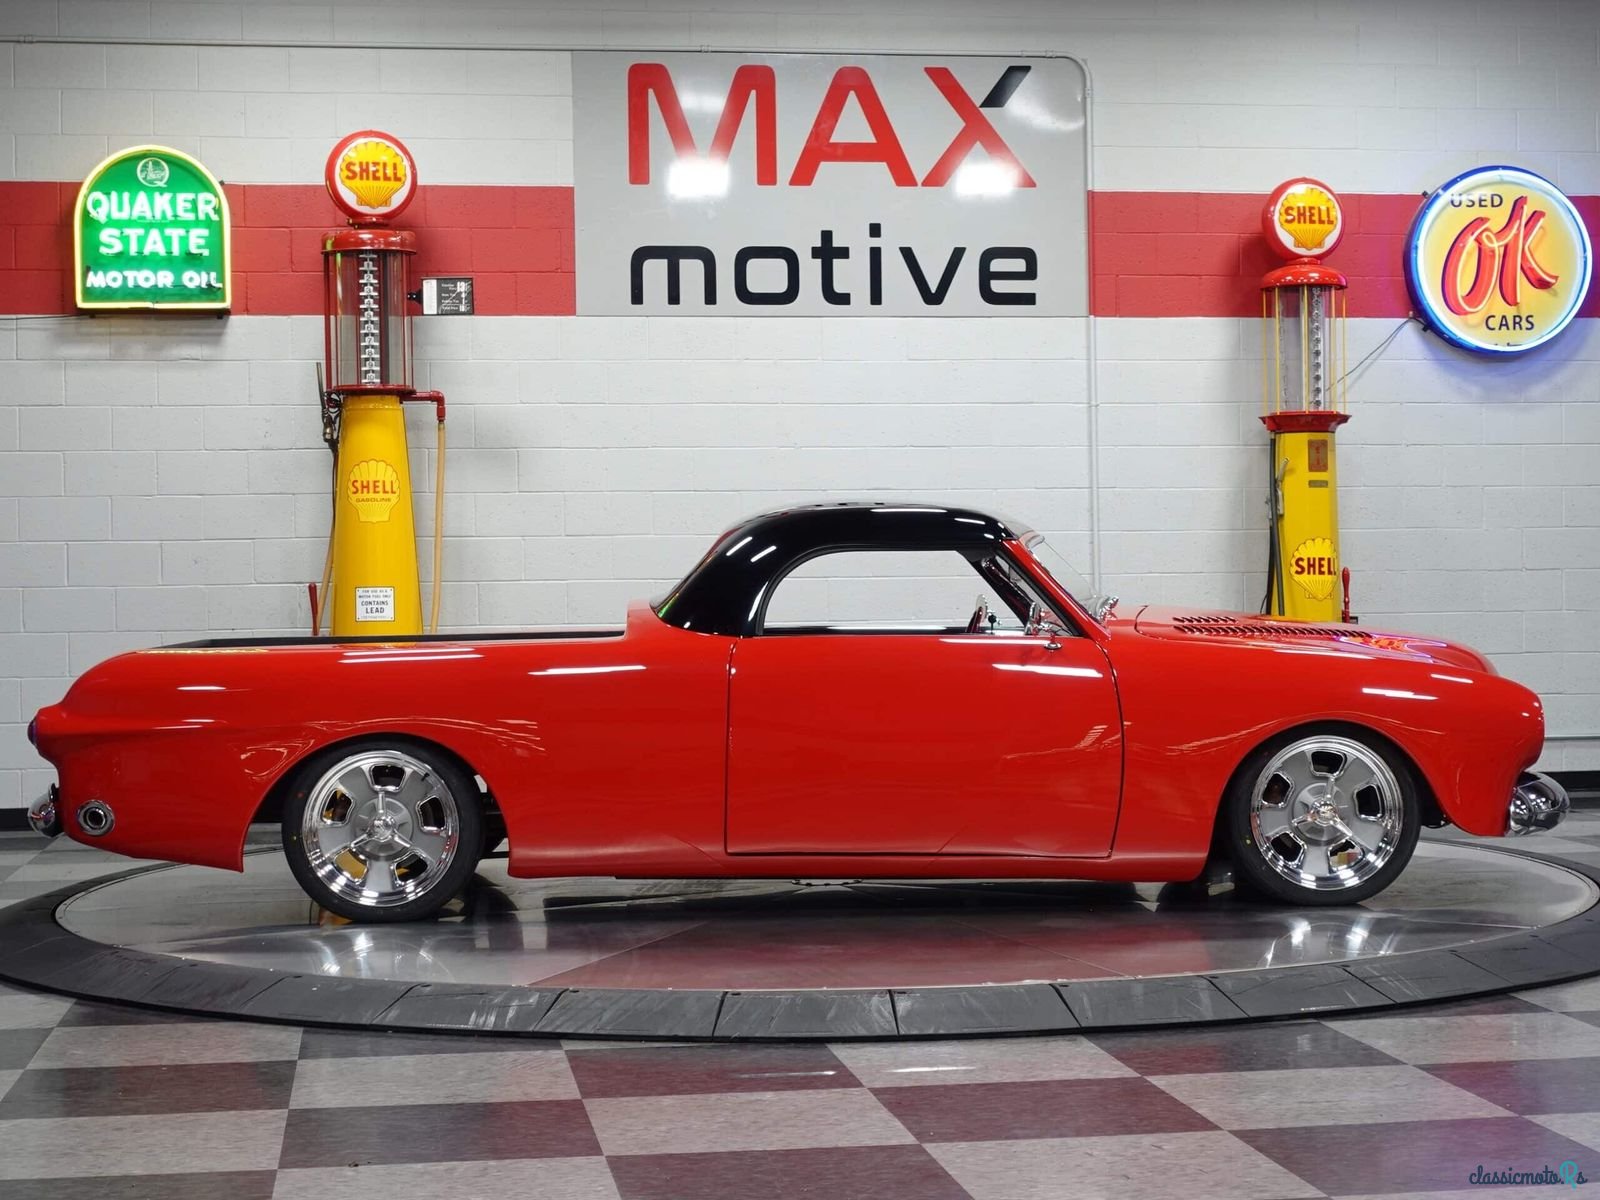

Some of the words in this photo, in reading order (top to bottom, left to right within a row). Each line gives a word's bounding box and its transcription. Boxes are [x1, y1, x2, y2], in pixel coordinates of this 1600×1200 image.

[627, 63, 1037, 188] MAX
[345, 161, 402, 182] SHELL
[86, 190, 220, 224] QUAKER
[1450, 192, 1504, 208] USED
[1284, 205, 1335, 226] SHELL
[98, 227, 210, 256] STATE
[630, 222, 1037, 306] motive
[1441, 195, 1559, 316] OK
[86, 270, 175, 289] MOTOR
[182, 270, 223, 289] OIL
[1485, 314, 1535, 331] CARS
[352, 480, 396, 494] SHELL
